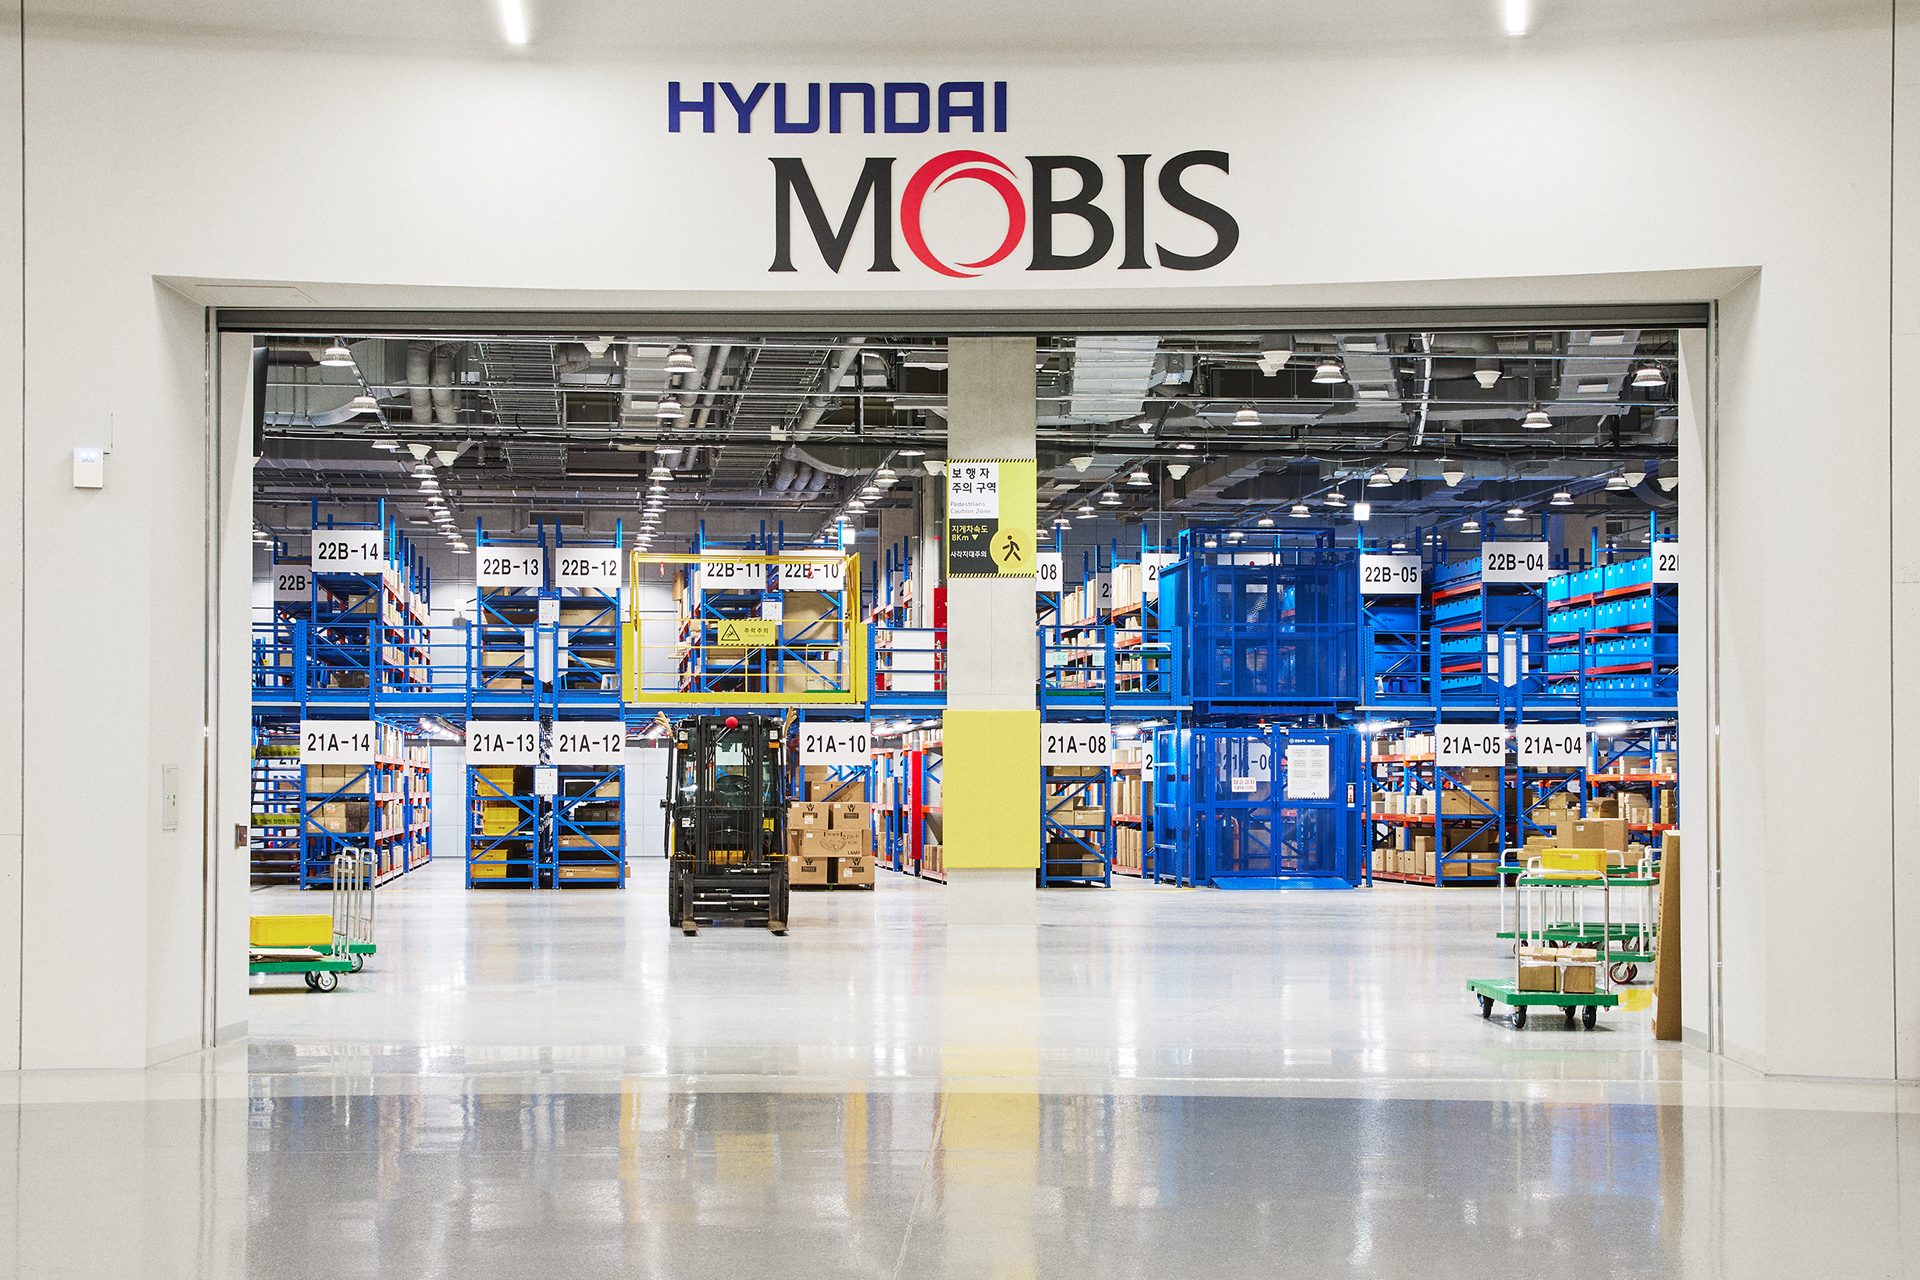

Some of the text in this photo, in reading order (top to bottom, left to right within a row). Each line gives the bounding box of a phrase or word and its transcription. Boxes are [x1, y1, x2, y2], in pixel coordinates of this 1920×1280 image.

[669, 81, 1007, 133] HYUNDAI
[768, 150, 1239, 278] MOBIS
[952, 482, 996, 494] 주의 구역
[951, 534, 969, 542] 8Km
[319, 542, 378, 559] 22B-14
[484, 559, 538, 575] 22B-13
[562, 560, 616, 575] 22B-12
[708, 563, 759, 577] 22B-11
[1489, 554, 1543, 570] 22B-04
[1659, 554, 1679, 571] 22
[1365, 567, 1418, 582] 22B-05
[308, 734, 369, 751] 21A-14
[474, 734, 534, 751] 21A-13
[560, 735, 619, 752] 21A-12
[807, 735, 865, 752] 21A-10
[1048, 736, 1106, 753] 21A-08
[1444, 737, 1500, 753] 21A-05
[1525, 737, 1581, 754] 21A-04
